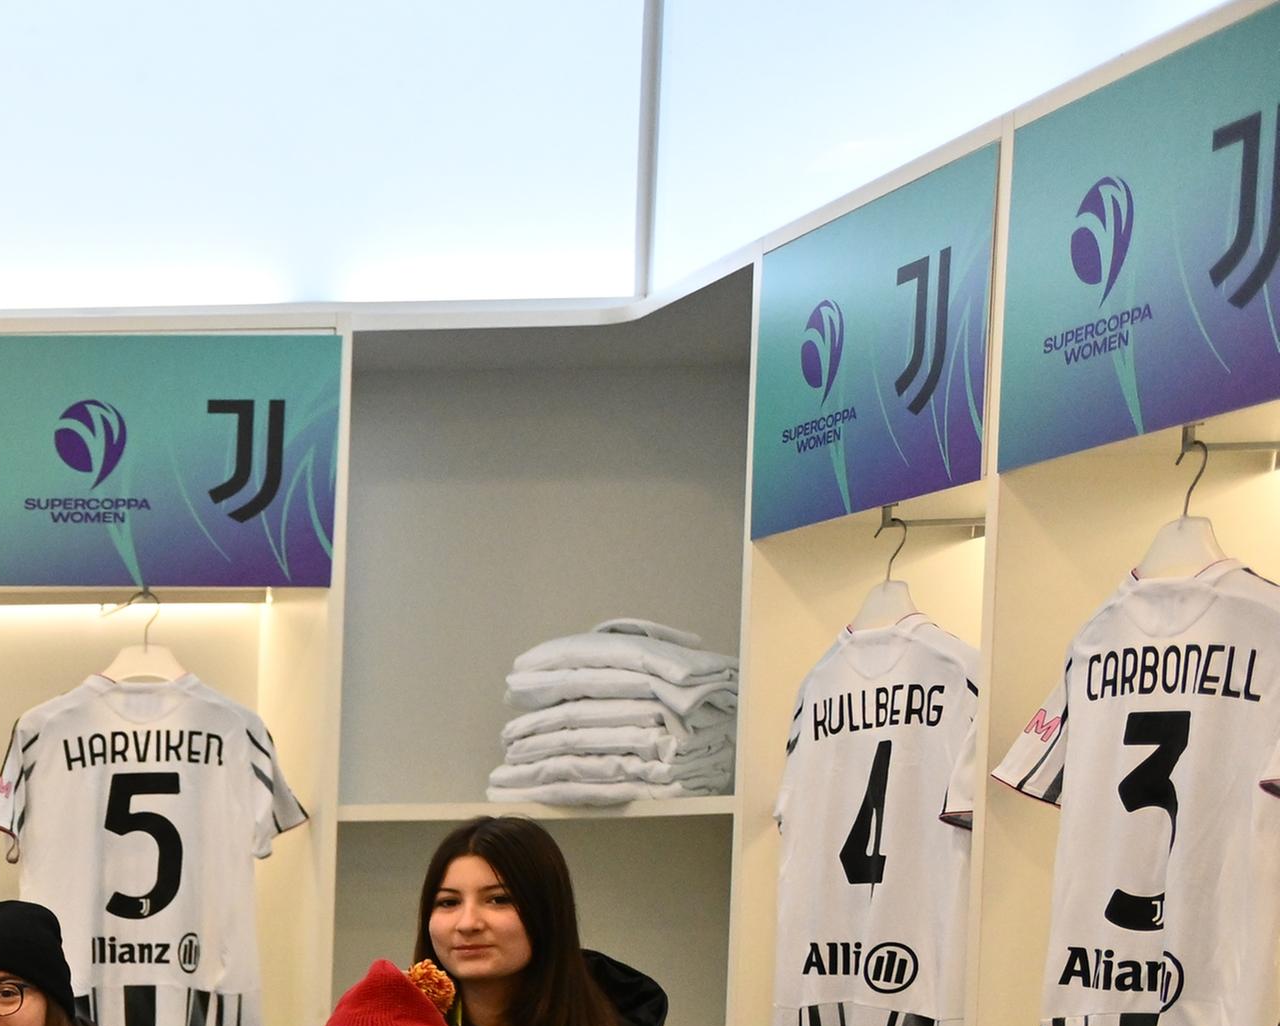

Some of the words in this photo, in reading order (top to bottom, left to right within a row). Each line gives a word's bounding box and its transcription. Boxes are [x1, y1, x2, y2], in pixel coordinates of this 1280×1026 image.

[1043, 303, 1153, 355] SUPERCOPPA
[1064, 330, 1130, 366] WOMEN
[782, 406, 857, 444] SUPERCOPPA
[796, 428, 841, 454] WOMEN
[24, 497, 151, 512] SUPERCOPPA
[50, 510, 126, 524] WOMEN
[1086, 644, 1262, 703] CARBONELL
[813, 683, 945, 741] KULLBERG
[63, 730, 224, 771] HARVIKEN
[839, 740, 892, 885] 4
[1104, 711, 1191, 931] 3
[104, 772, 183, 920] 5
